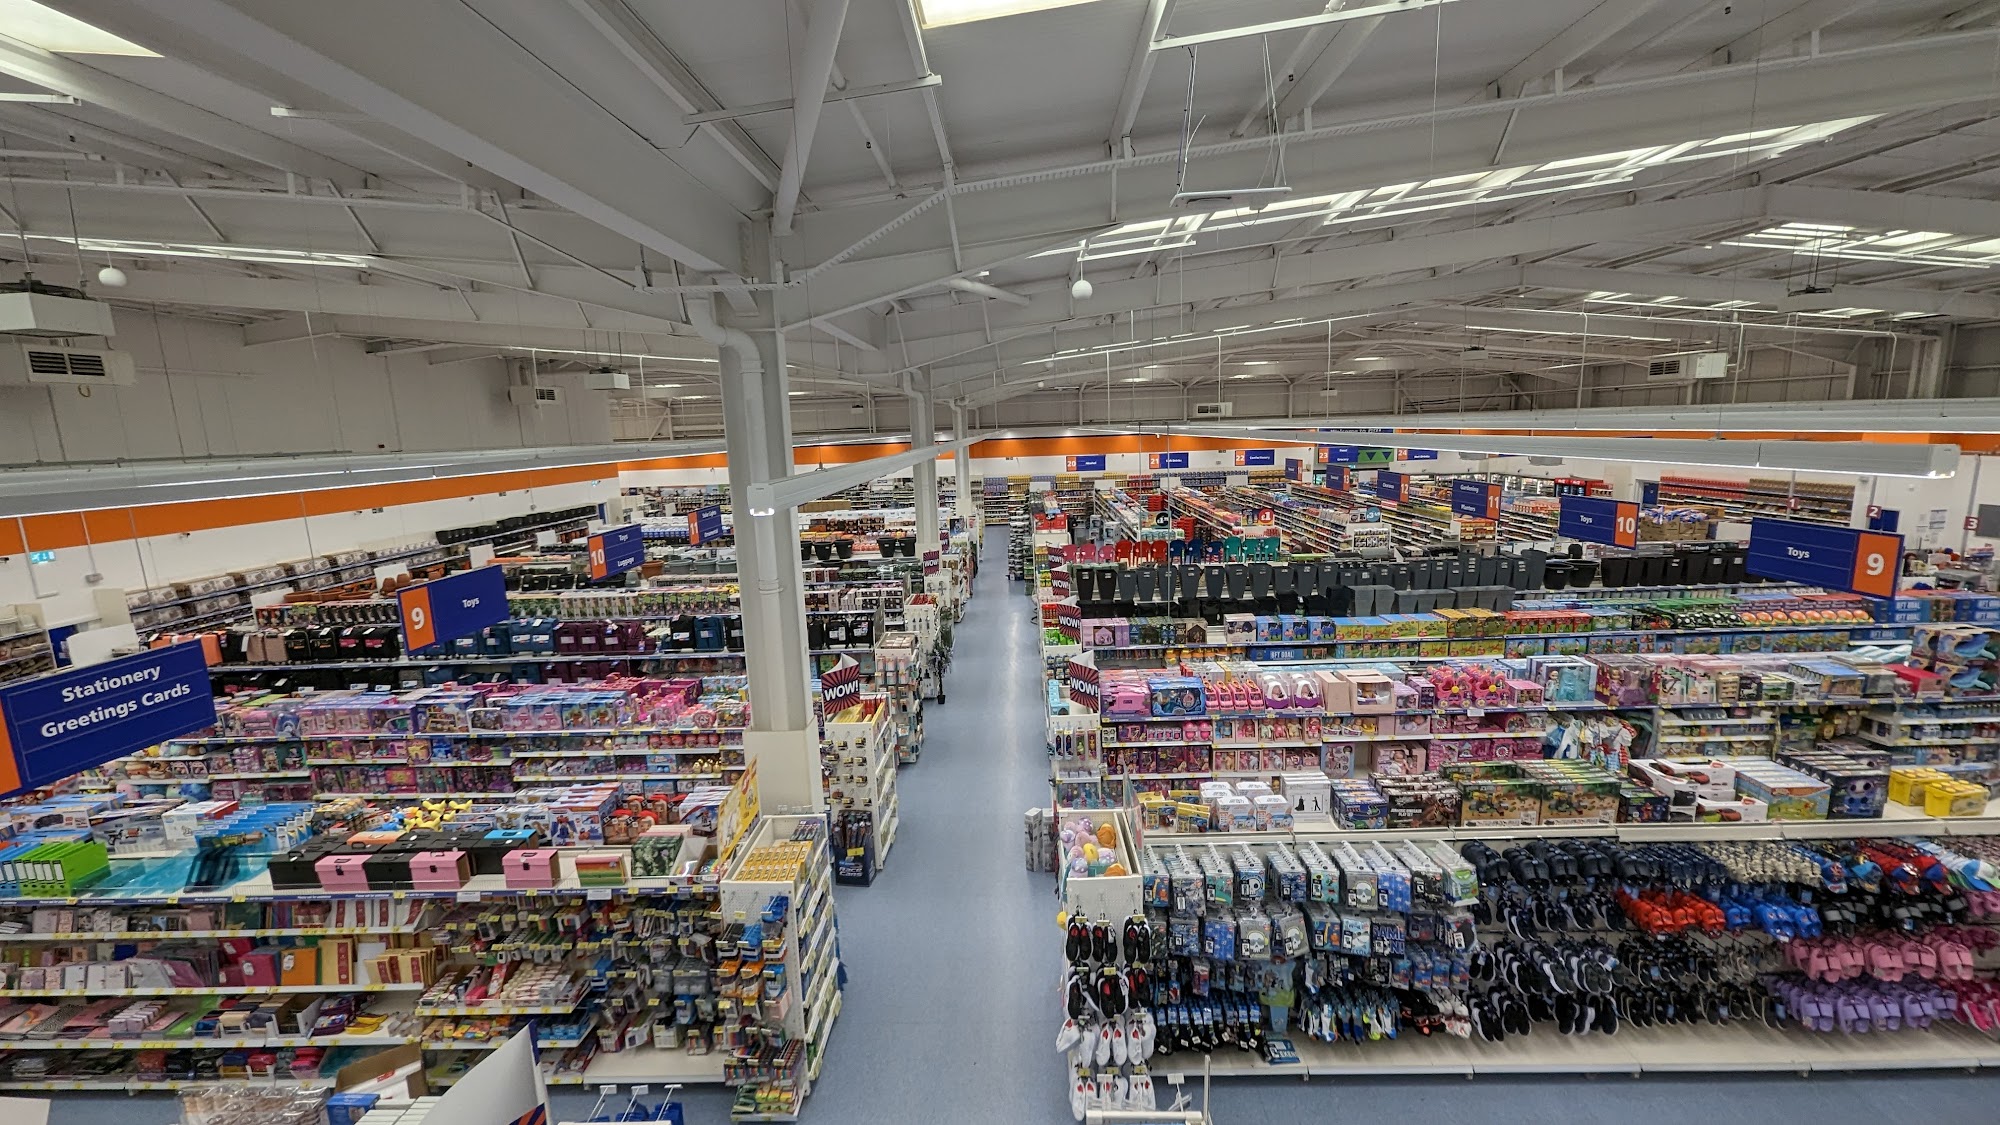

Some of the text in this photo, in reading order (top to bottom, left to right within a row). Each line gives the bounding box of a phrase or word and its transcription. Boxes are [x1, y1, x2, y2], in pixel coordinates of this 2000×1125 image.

[1398, 448, 1408, 456] 24
[1150, 457, 1160, 465] 21
[1400, 482, 1409, 495] 12
[1460, 484, 1479, 494] Gardening
[1488, 495, 1499, 509] 11
[1789, 499, 1796, 508] 1
[1869, 506, 1879, 517] 2
[1579, 514, 1593, 525] Toys
[1617, 516, 1636, 534] 10
[1968, 519, 1978, 529] 3
[689, 522, 699, 535] 11
[618, 533, 629, 542] Toys
[590, 548, 606, 566] 10
[1787, 546, 1810, 559] Toys
[617, 556, 635, 567] Luggage
[1866, 553, 1885, 576] 9
[1051, 578, 1069, 589] WOW!
[462, 597, 480, 608] Toys
[411, 607, 425, 630] 9
[1059, 615, 1081, 629] WOW!
[61, 665, 161, 702] Stationery
[824, 679, 859, 701] WOW!
[1070, 676, 1099, 697] WOW!
[41, 683, 191, 738] Greetings Cards
